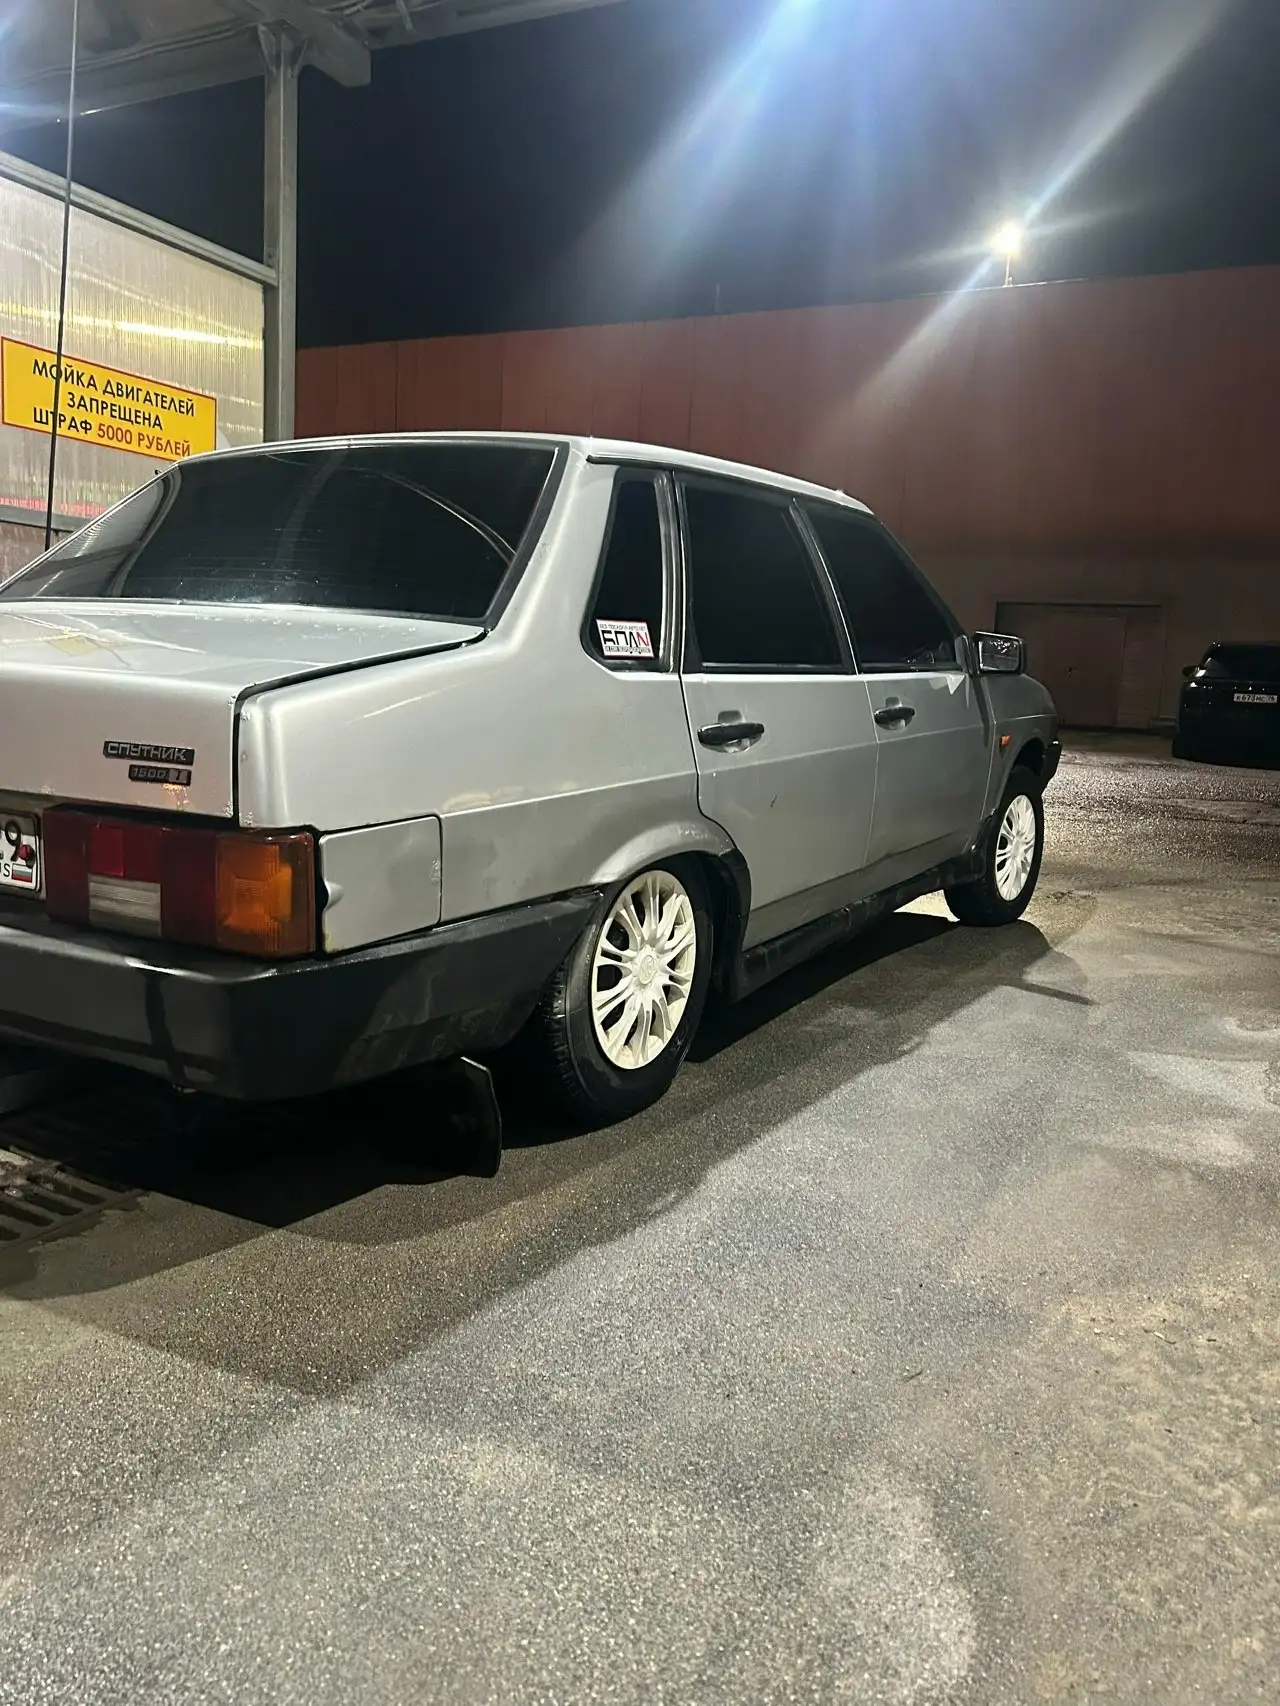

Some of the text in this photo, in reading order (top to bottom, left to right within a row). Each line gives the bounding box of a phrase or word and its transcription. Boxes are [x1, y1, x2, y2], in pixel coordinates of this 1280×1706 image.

[33, 359, 195, 417] МОЙКА ДВИГАТЕЛЕЙ
[67, 391, 163, 431] ЗАПРЕЩЕНА
[97, 423, 133, 445] 5000
[137, 432, 191, 457] РУБЛЕЙ
[107, 742, 187, 761] СПУТНИК
[133, 767, 166, 779] 1500
